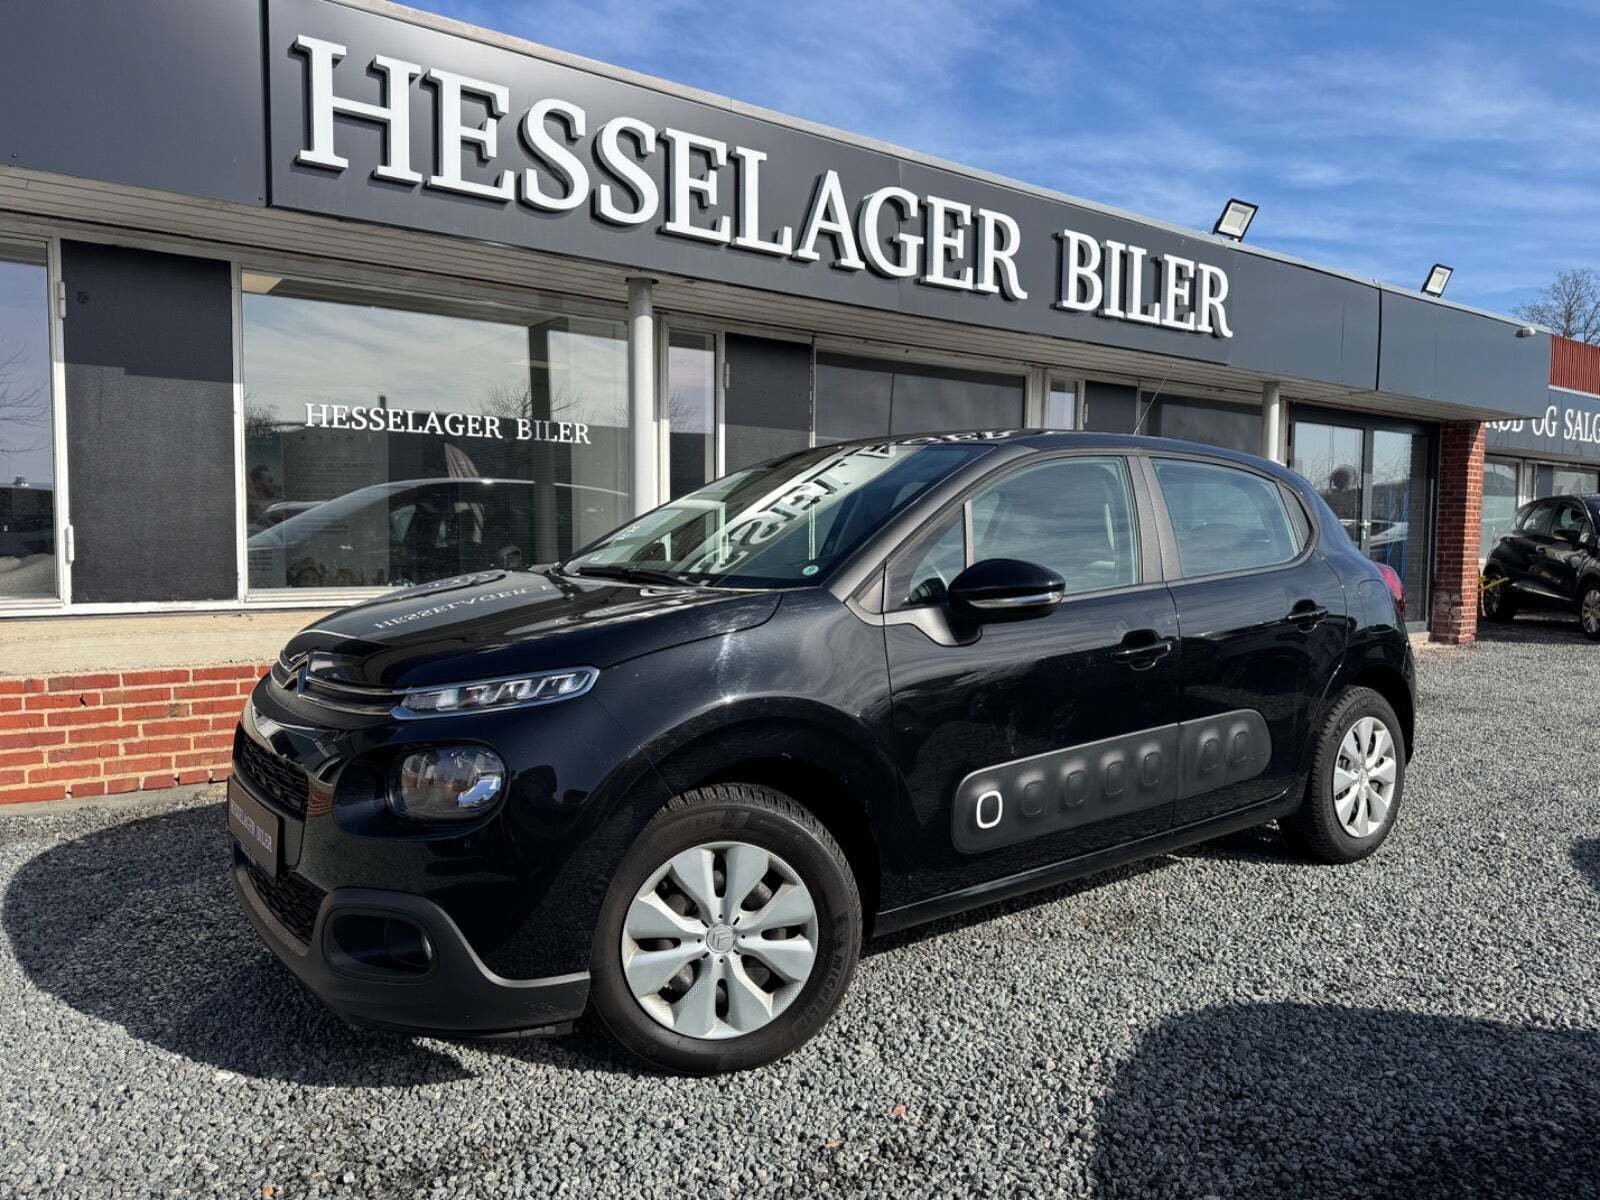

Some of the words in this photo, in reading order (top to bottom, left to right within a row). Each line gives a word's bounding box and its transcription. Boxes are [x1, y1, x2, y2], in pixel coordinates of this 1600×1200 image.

[296, 34, 1028, 300] HESSELAGER
[1058, 229, 1233, 338] BILER
[304, 402, 503, 439] HESSELAGER
[516, 418, 592, 445] BILER
